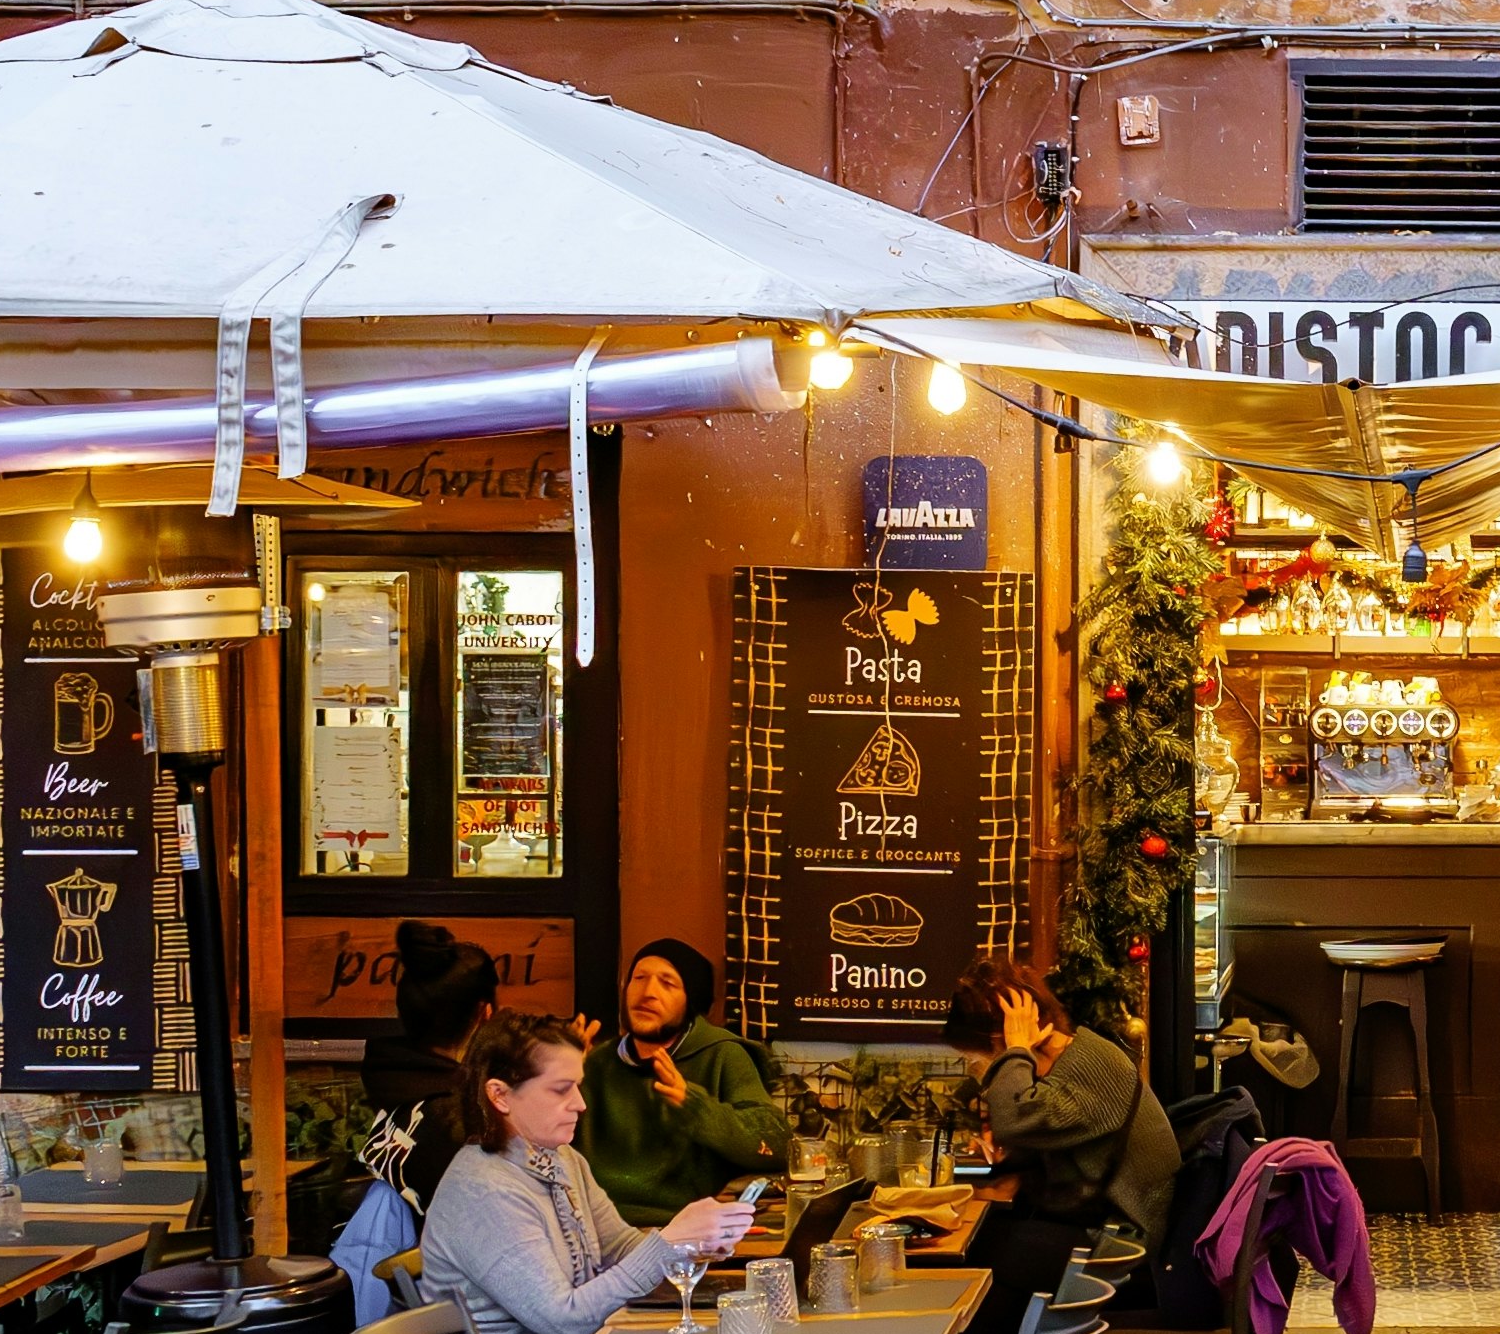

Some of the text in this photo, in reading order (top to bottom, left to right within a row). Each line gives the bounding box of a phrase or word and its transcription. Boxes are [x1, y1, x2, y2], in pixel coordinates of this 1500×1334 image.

[340, 451, 560, 499] ndwich
[875, 500, 976, 528] LAVAZZA
[29, 571, 99, 611] Cockt
[459, 614, 555, 626] JOHN CABOT
[464, 636, 553, 649] UNIVERSITY
[845, 646, 922, 685] Pasta
[808, 693, 874, 705] GUSTOSA
[894, 695, 961, 707] CREMOSA
[43, 761, 109, 801] Beer
[483, 799, 504, 813] OF
[20, 807, 135, 820] NAZIONALE E
[839, 801, 918, 841] Pizza
[30, 825, 125, 838] IMPORTATE
[795, 847, 854, 859] SOFFICE
[312, 923, 562, 1010] pani
[830, 953, 927, 993] Panino
[40, 973, 124, 1023] Coffee
[794, 996, 870, 1009] GENEROSO
[37, 1028, 127, 1041] INTENSO E
[56, 1045, 109, 1058] FORTE
